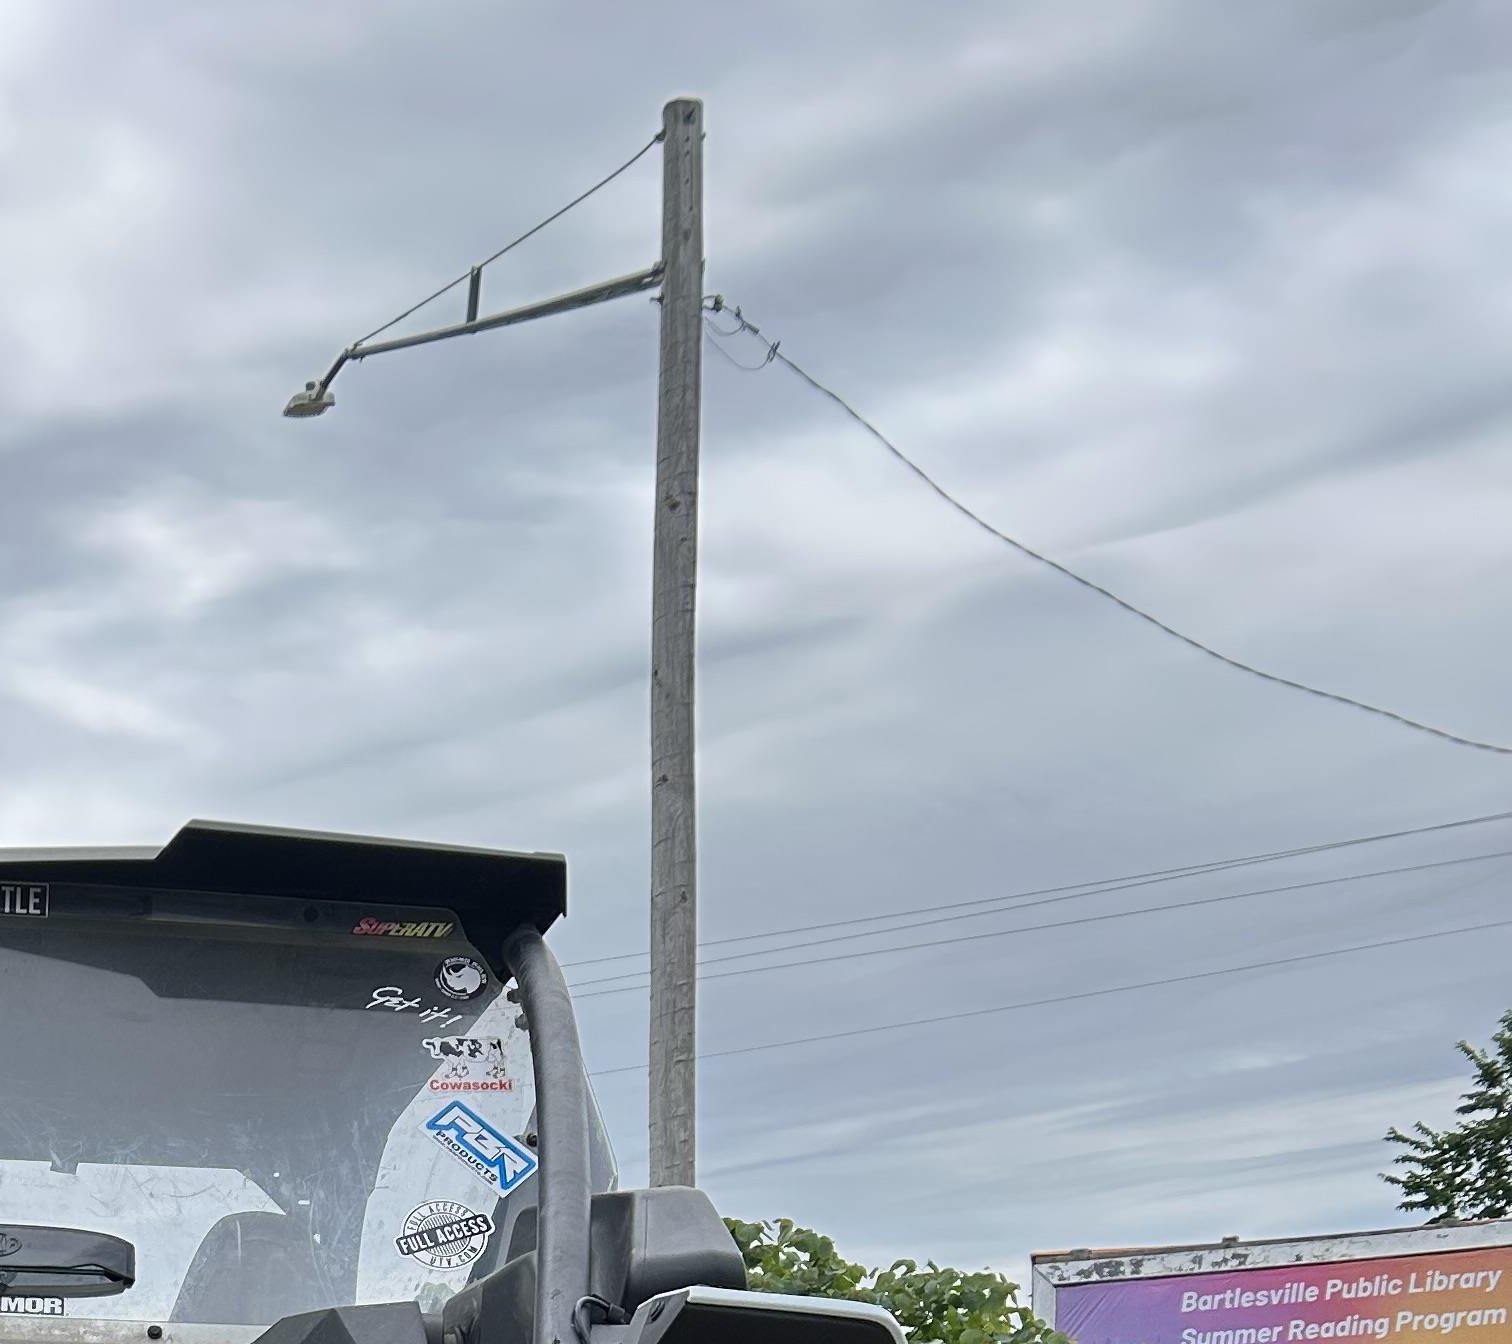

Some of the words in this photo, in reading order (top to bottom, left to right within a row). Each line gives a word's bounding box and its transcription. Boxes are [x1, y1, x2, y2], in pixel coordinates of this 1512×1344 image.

[353, 917, 454, 937] SUPERATV
[429, 1079, 513, 1091] Cowasocki
[435, 1130, 499, 1182] PRODUCTS
[407, 1211, 427, 1231] FULL
[429, 1203, 469, 1217] ACCESS
[399, 1232, 435, 1254] FULL
[435, 1216, 488, 1244] ACCESS
[1180, 1282, 1320, 1313] Bartlesville
[1325, 1274, 1403, 1301] Public
[1408, 1267, 1504, 1294] Library
[1288, 1314, 1390, 1340] Reading
[1395, 1306, 1508, 1335] Program
